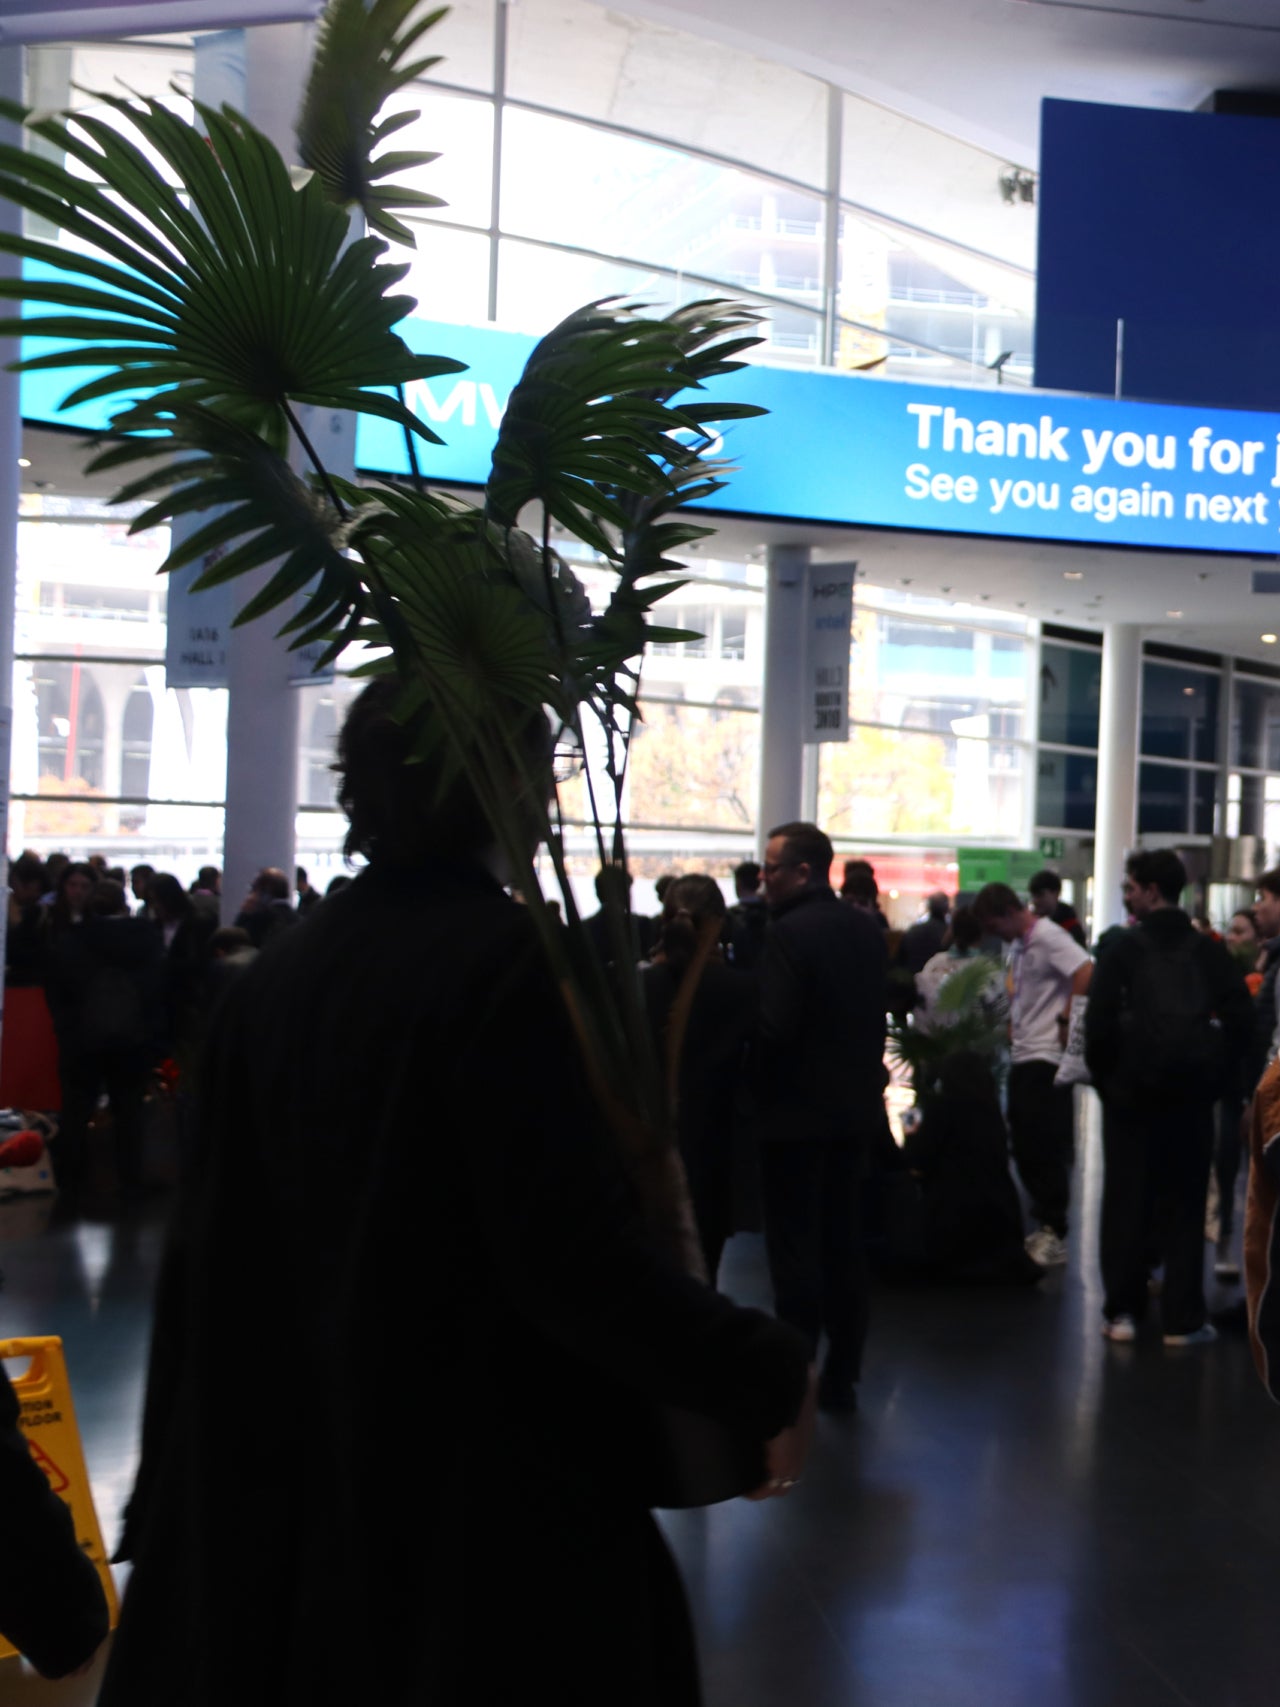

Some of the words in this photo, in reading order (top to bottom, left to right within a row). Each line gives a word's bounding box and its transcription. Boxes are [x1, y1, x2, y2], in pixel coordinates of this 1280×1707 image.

[906, 402, 1070, 463] Thank
[1081, 428, 1177, 475] you
[1188, 426, 1265, 476] for
[903, 462, 980, 505] See
[988, 477, 1061, 515] you
[1069, 481, 1175, 523] again
[1184, 491, 1269, 525] next
